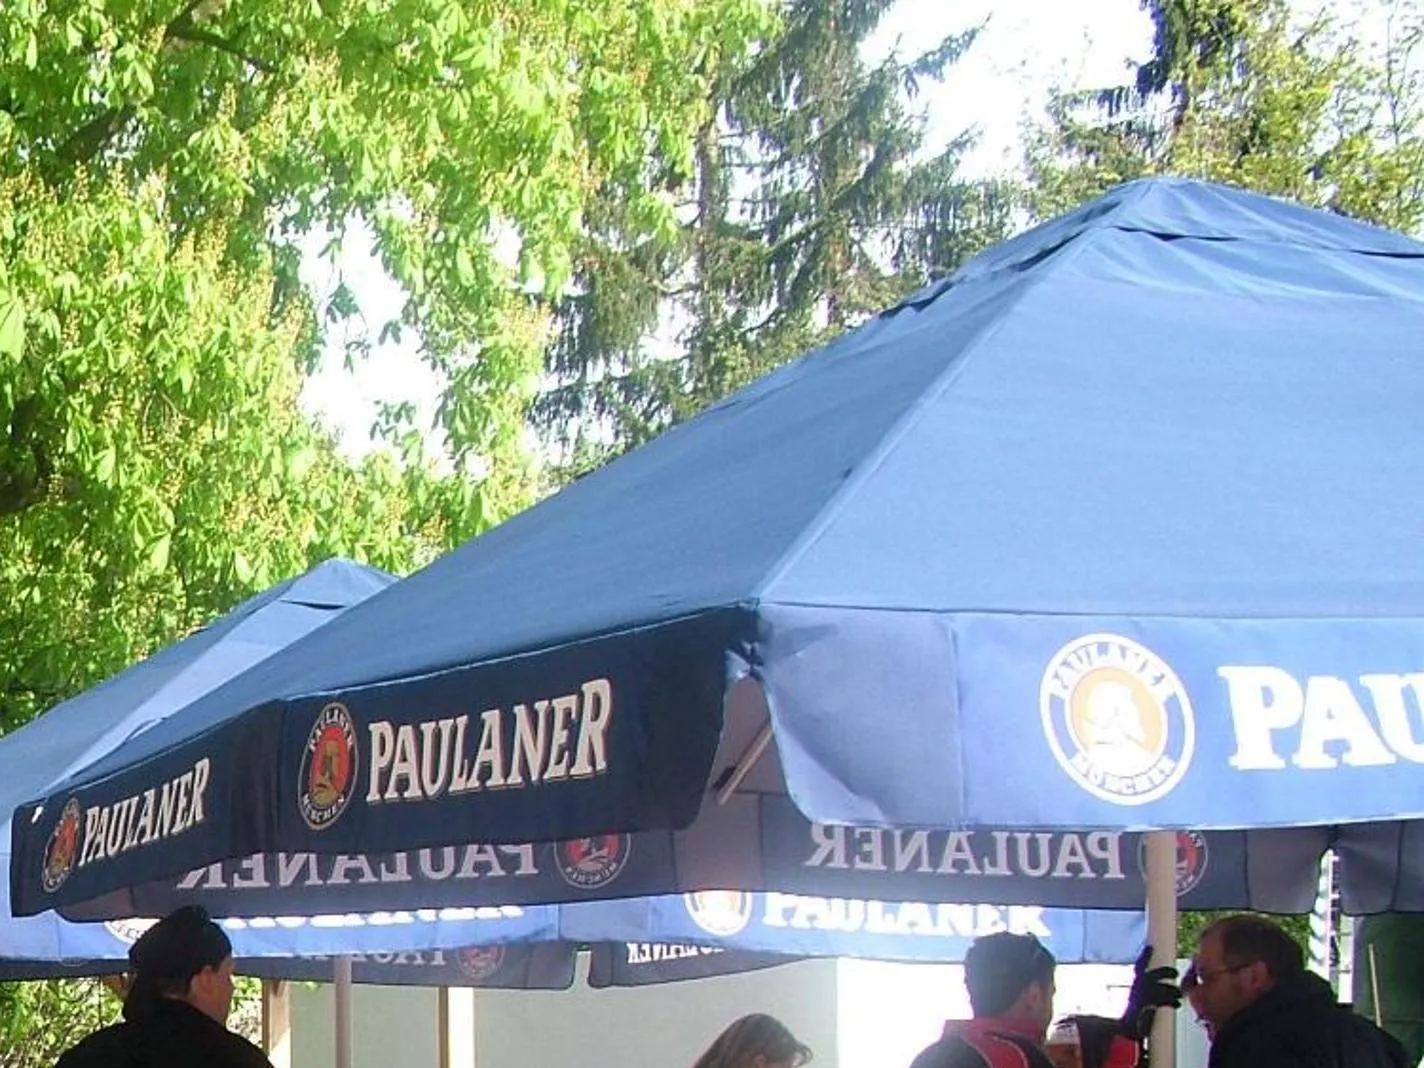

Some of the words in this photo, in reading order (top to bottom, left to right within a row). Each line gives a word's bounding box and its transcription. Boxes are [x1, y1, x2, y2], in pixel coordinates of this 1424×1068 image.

[366, 678, 613, 803] PAULANER
[1216, 666, 1424, 771] PAU
[79, 757, 211, 868] PAULANER
